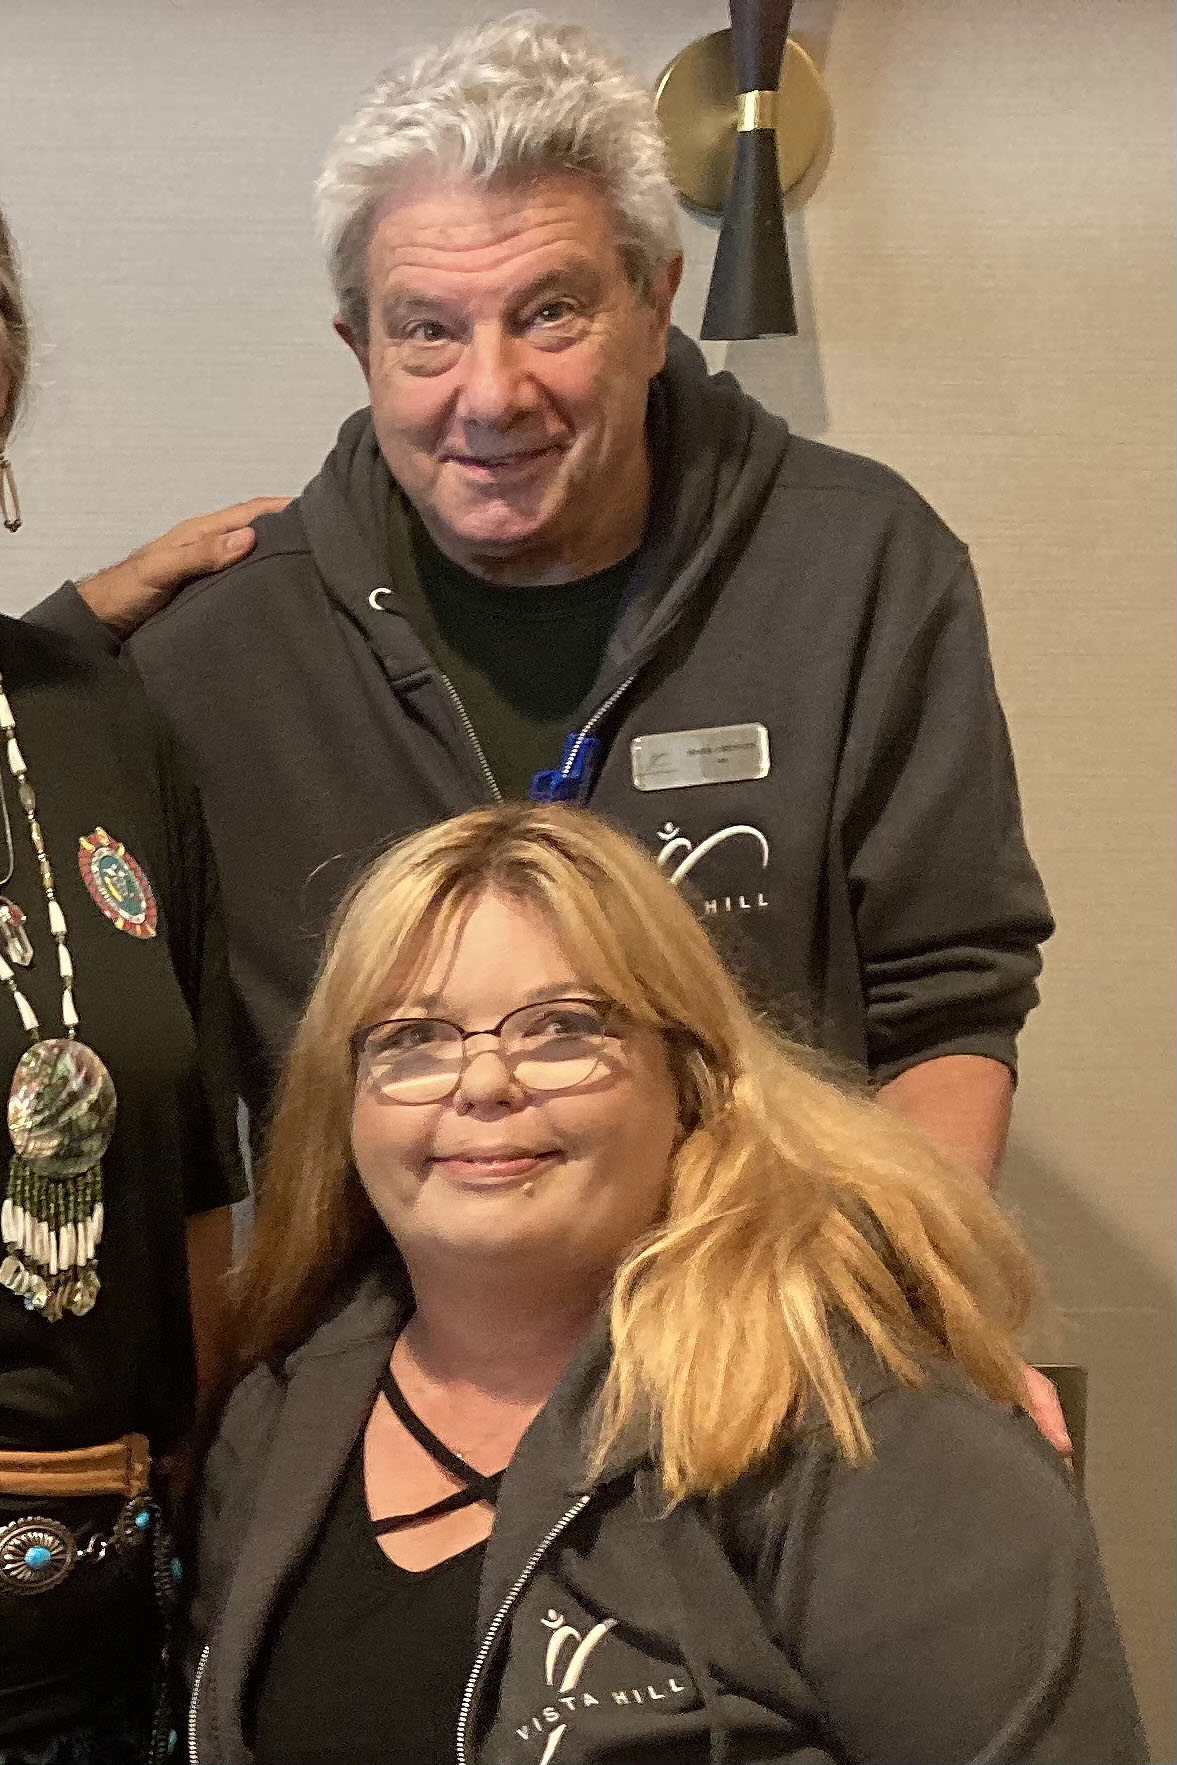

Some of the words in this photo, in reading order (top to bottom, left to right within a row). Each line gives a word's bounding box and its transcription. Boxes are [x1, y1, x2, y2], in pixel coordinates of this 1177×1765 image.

[704, 892, 769, 915] HILL
[515, 1692, 600, 1741] VISTA
[611, 1678, 685, 1705] HILL
